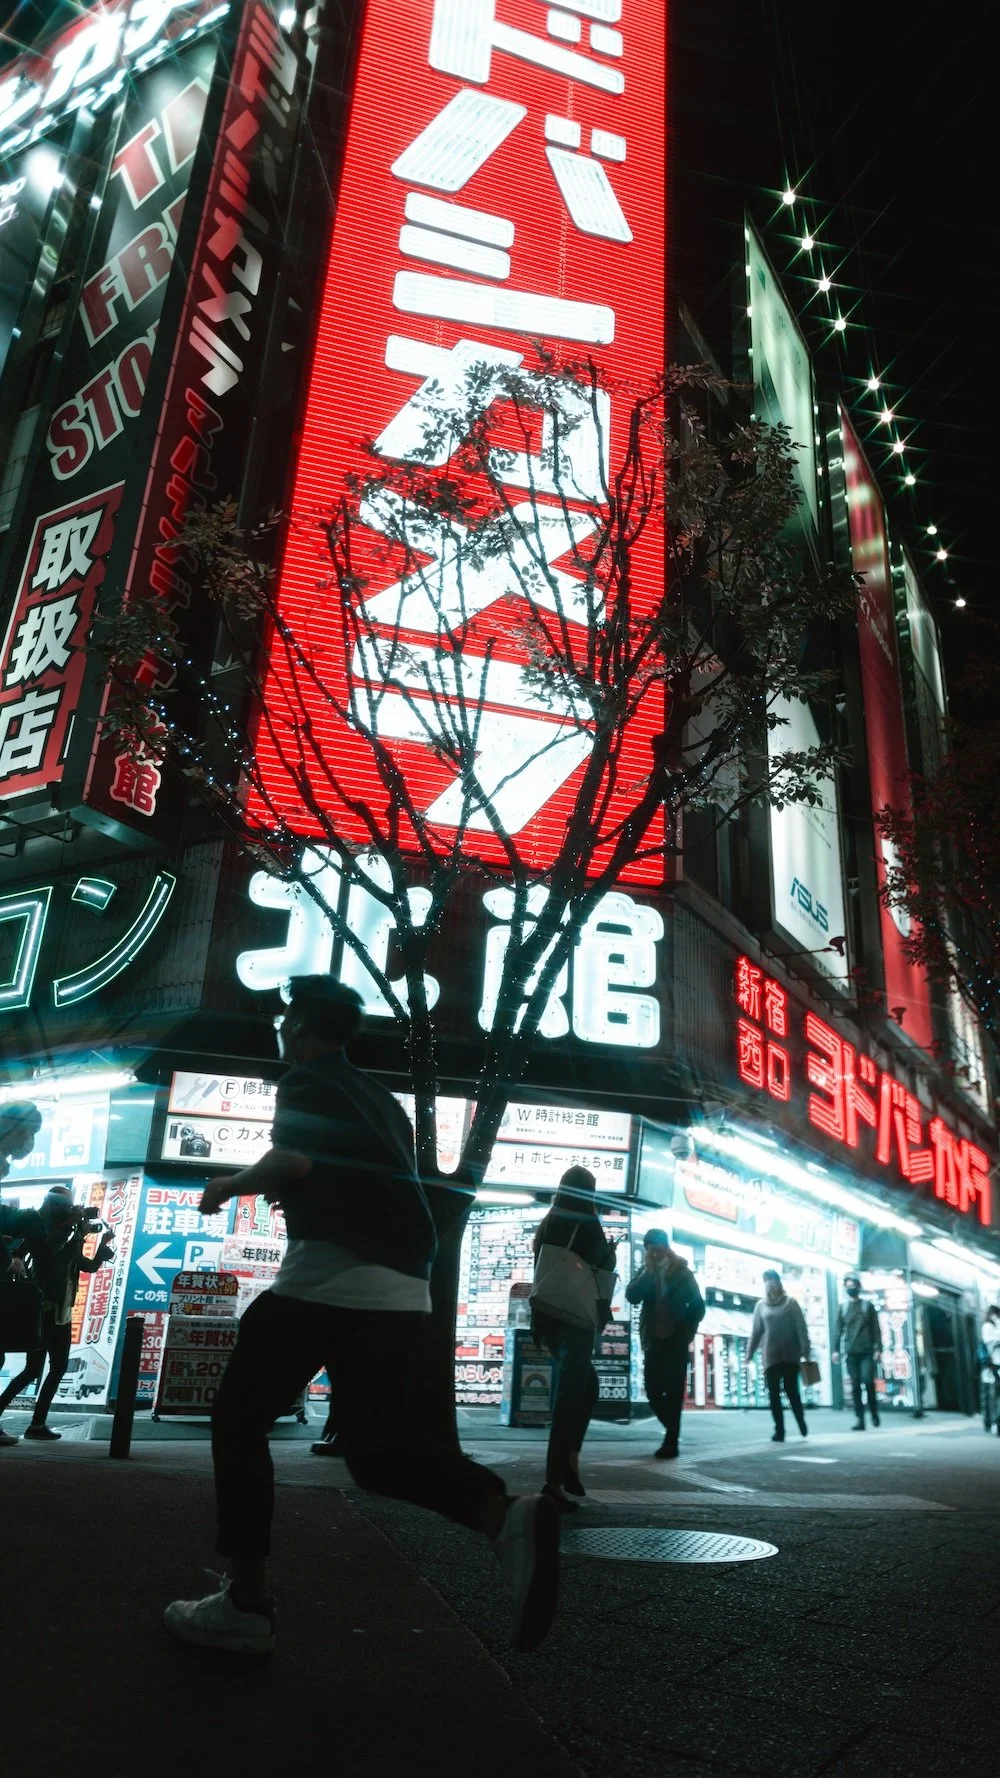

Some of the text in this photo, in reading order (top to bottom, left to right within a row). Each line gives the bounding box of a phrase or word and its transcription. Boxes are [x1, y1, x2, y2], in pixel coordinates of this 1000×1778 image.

[110, 62, 214, 211] TA
[46, 320, 161, 482] STO
[345, 0, 634, 836] ドバシカメラ
[0, 508, 104, 778] 取扱店
[790, 876, 829, 933] ASUS
[735, 954, 788, 1038] 新宿
[737, 1016, 791, 1102] 西口
[236, 1126, 273, 1142] カメ
[535, 1108, 599, 1127] 時計総合館
[805, 1009, 992, 1227] ヨドバシカメラ
[531, 1152, 624, 1171] ホビー・おもちゃ館
[143, 1207, 229, 1238] 駐車場
[190, 1246, 204, 1263] P
[243, 1247, 280, 1262] 年賀状
[134, 1289, 168, 1303] この先
[177, 1274, 218, 1289] 年賀状
